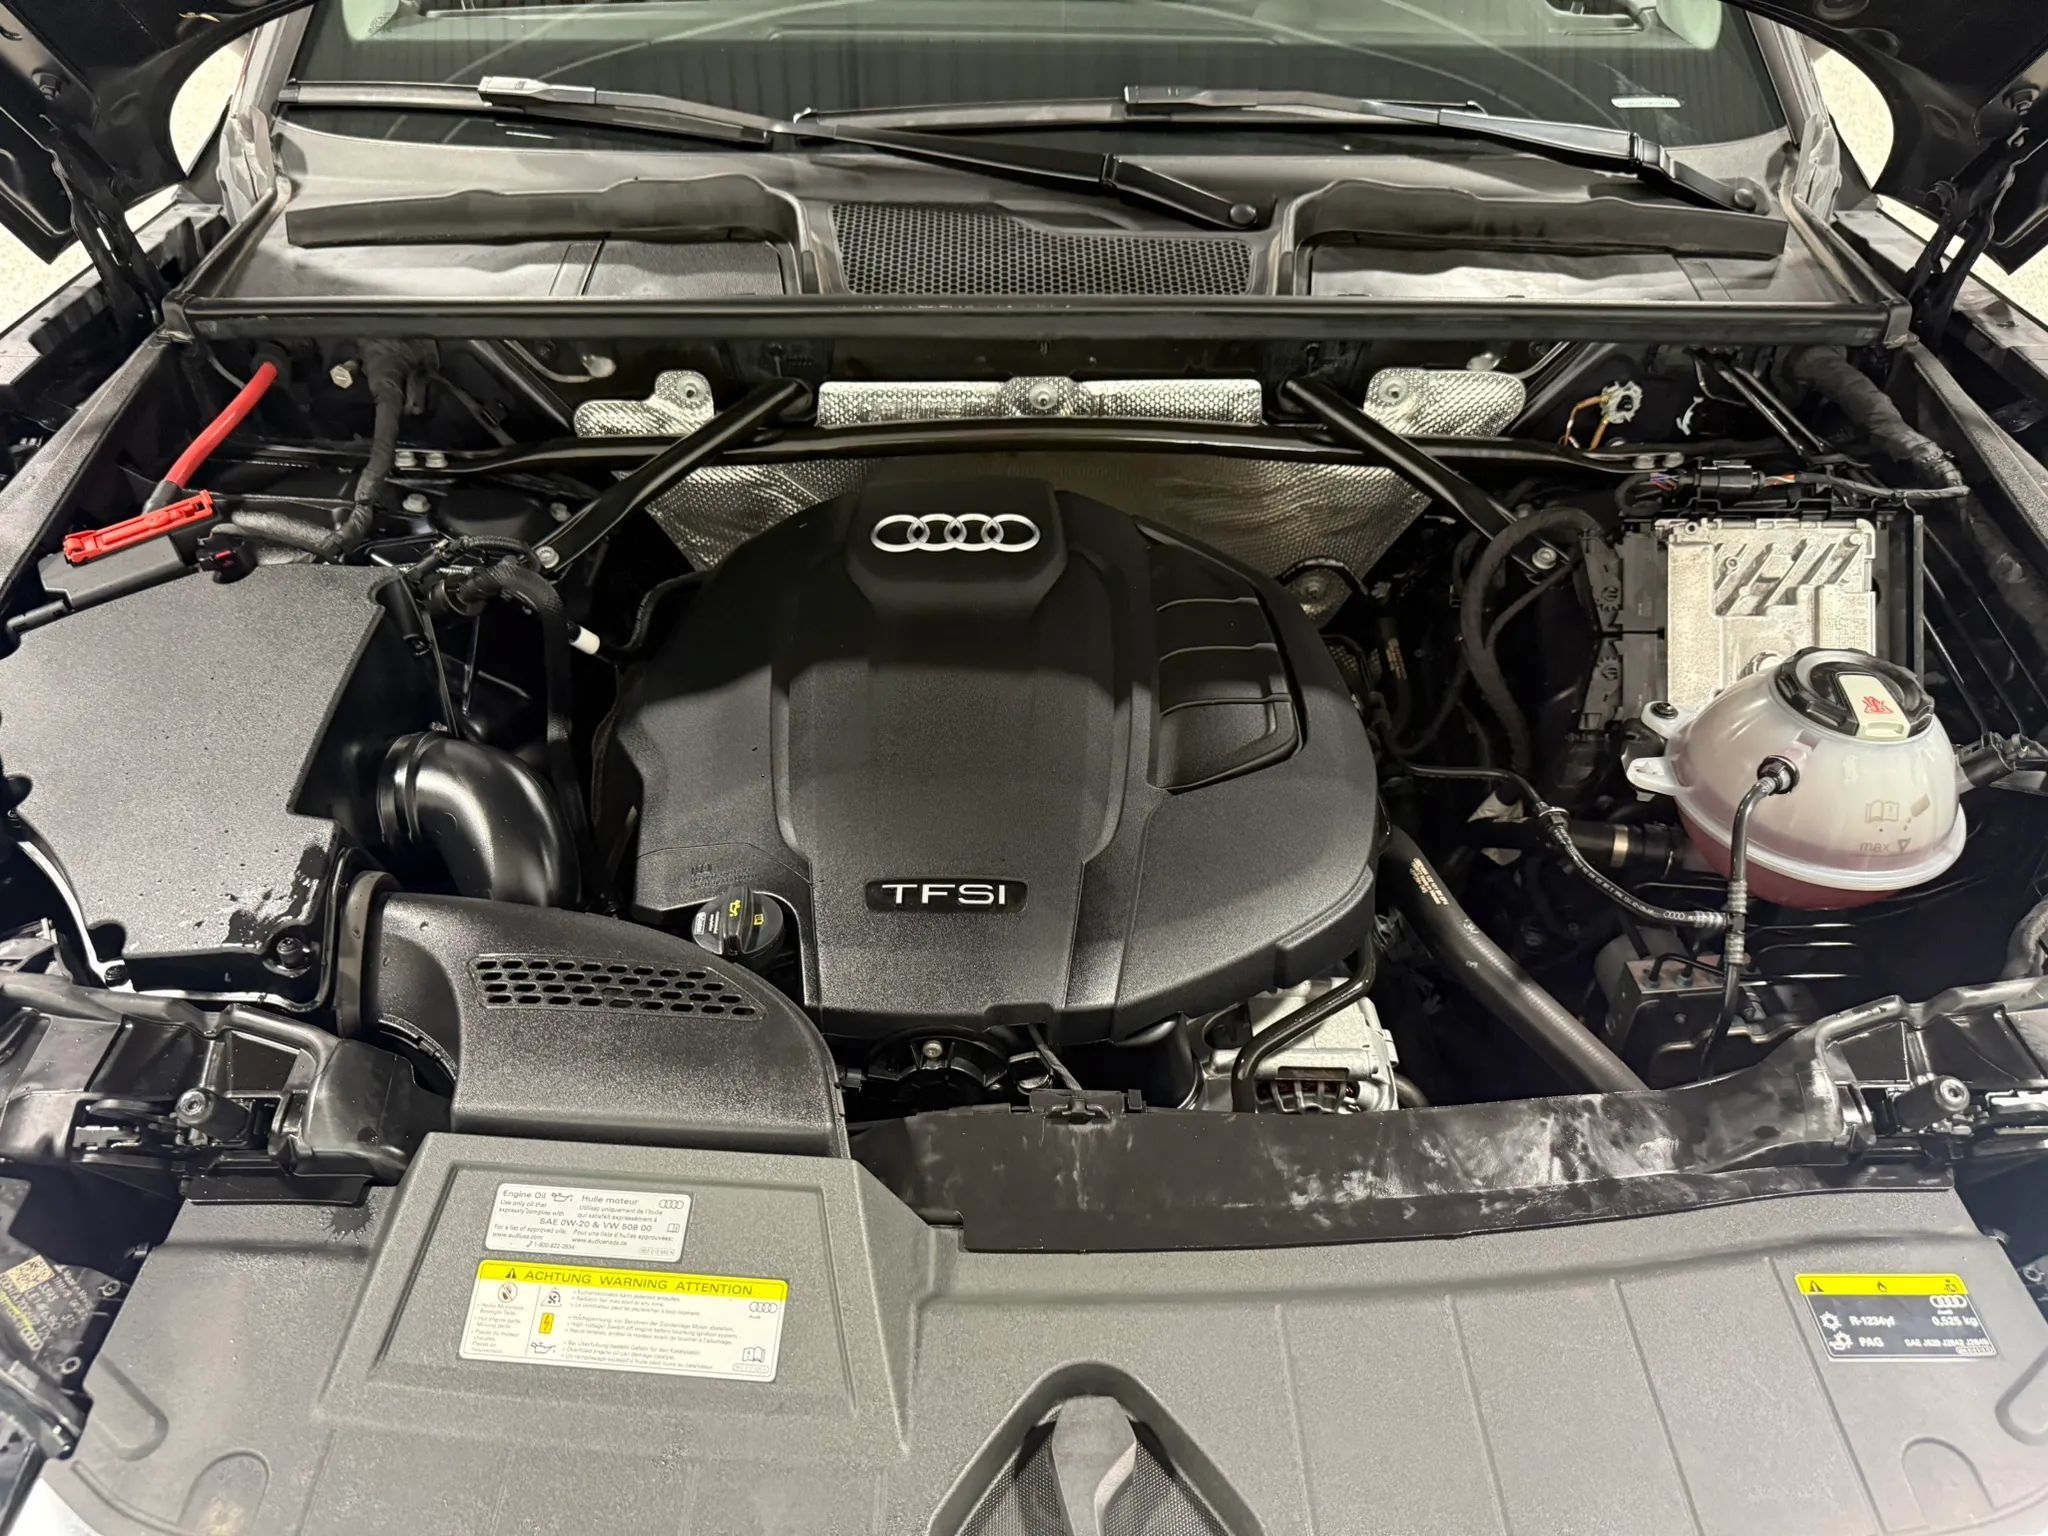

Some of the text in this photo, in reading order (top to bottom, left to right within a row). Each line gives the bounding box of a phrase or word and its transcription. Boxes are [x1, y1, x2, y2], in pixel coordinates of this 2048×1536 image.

[1860, 840, 1890, 852] max
[882, 884, 1005, 905] TFSI
[502, 1189, 532, 1198] Engine
[581, 1194, 603, 1202] Huile
[539, 1217, 558, 1225] SAE
[560, 1218, 590, 1227] 0W-20
[524, 1270, 753, 1295] ACHTUNG WARNING ATTENTION
[1849, 1315, 1895, 1328] R-1234yf
[1962, 1316, 1979, 1327] kg
[1859, 1336, 1884, 1347] PAG
